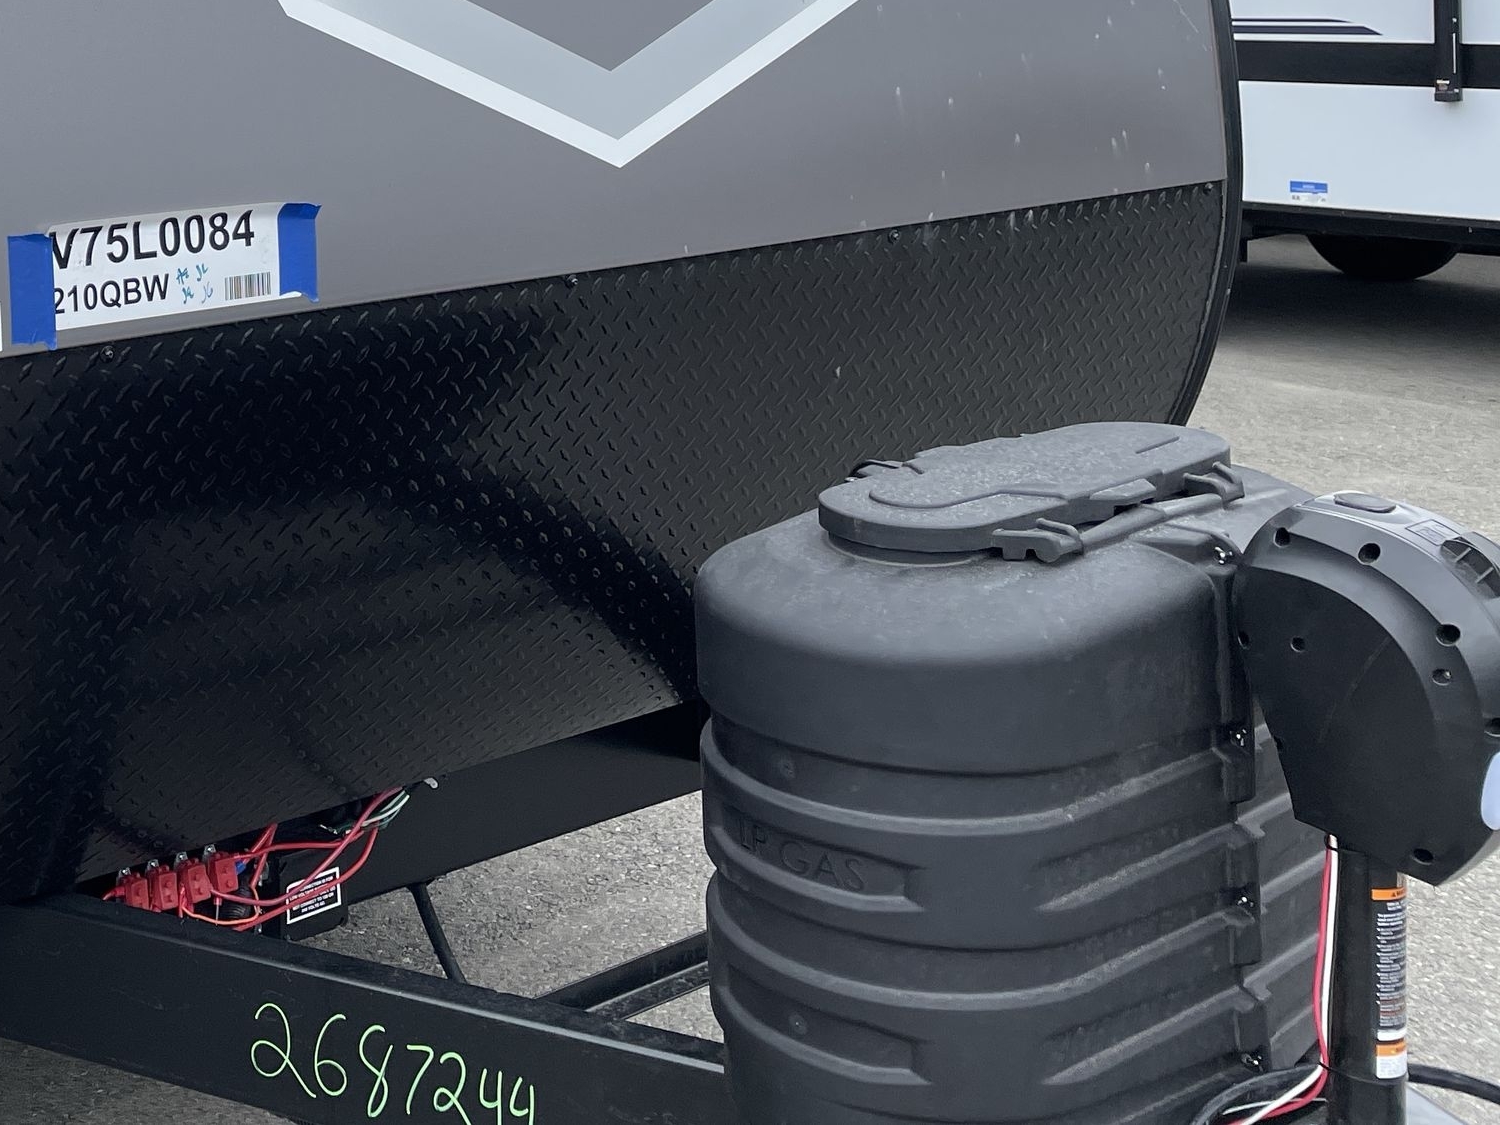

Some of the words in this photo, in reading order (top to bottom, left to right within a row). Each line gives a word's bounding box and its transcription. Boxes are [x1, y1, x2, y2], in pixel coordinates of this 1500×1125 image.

[52, 209, 255, 270] V75L0084
[54, 273, 169, 314] 210QBW
[780, 841, 865, 892] GAS
